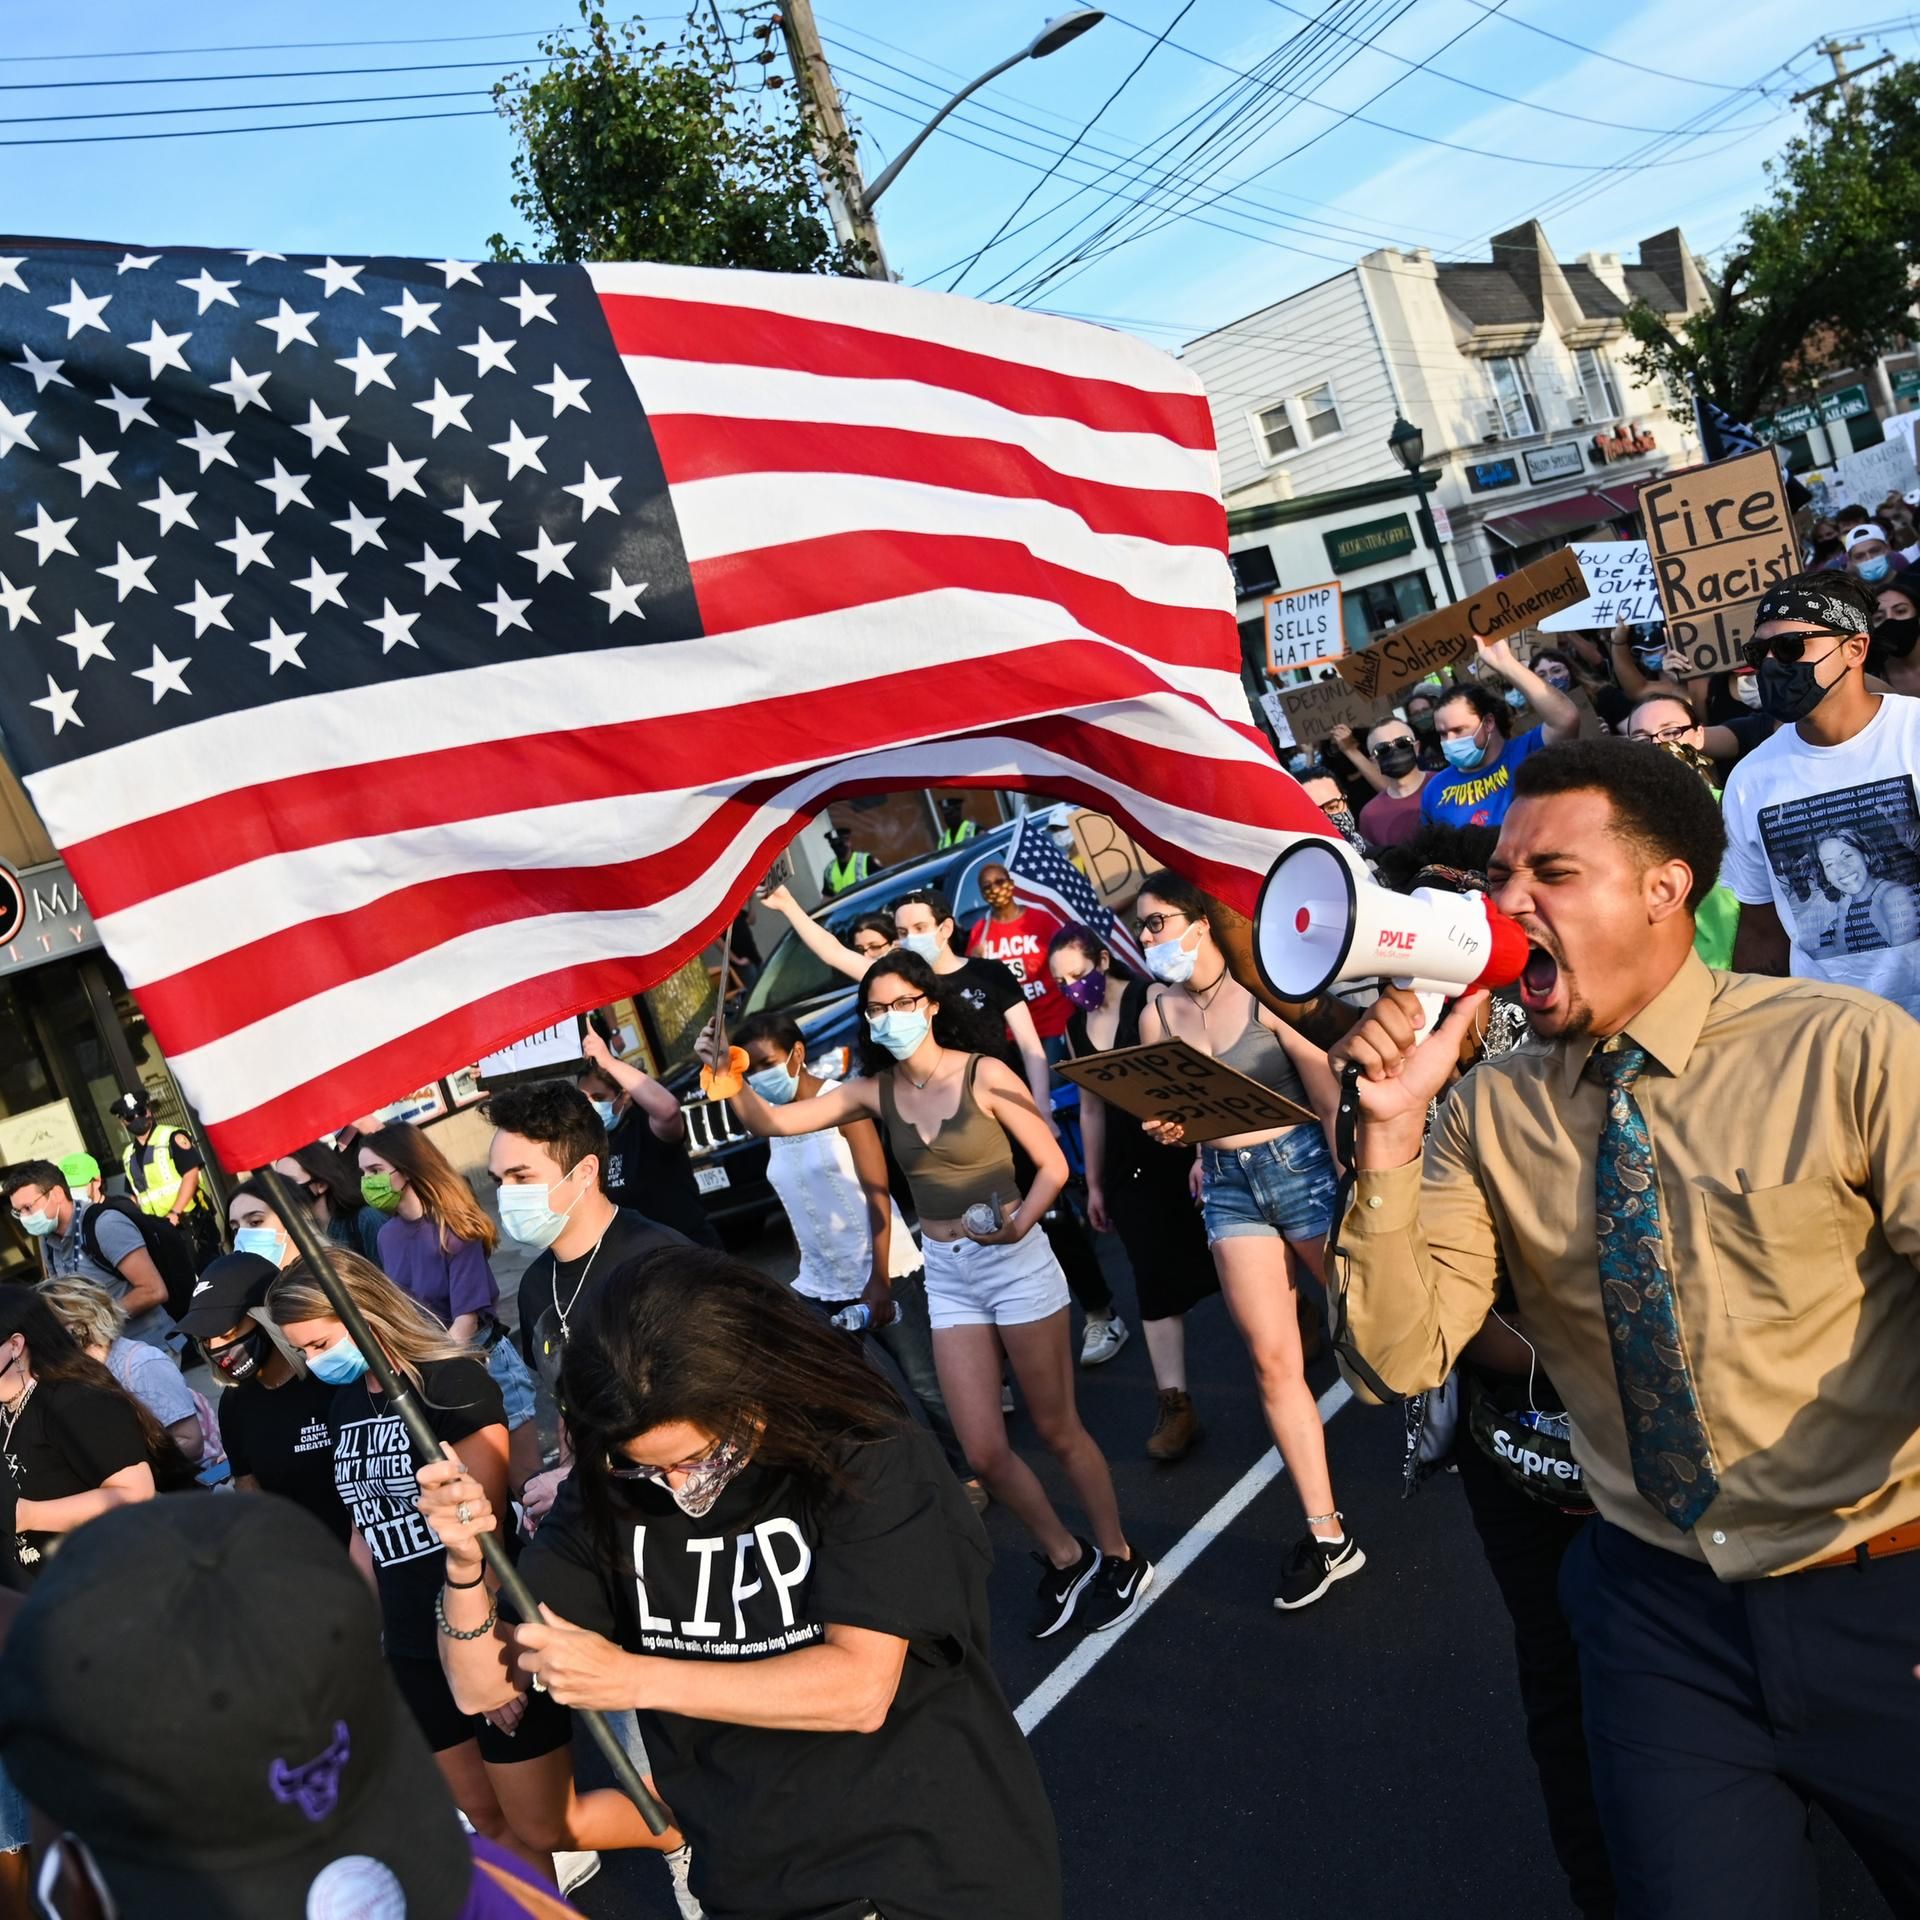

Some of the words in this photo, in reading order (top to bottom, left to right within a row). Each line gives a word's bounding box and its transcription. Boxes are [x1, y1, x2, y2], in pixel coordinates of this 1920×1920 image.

[1645, 483, 1779, 554] Fire
[1656, 543, 1792, 615] Racist
[1274, 589, 1331, 617] TRUMP
[1274, 615, 1327, 642] SELLS
[1383, 632, 1468, 678] Solitary
[1468, 566, 1579, 637] Confinement
[1274, 639, 1327, 667] HATE
[1672, 613, 1745, 670] Poli
[1353, 649, 1381, 699] Abolish
[1436, 764, 1509, 808] SPIDER-MAN
[1779, 803, 1808, 815] UARDIOLA.
[1378, 930, 1418, 950] PYLE
[1447, 924, 1479, 956] LIPP
[1085, 1049, 1216, 1082] Police
[1145, 1081, 1209, 1101] the
[1154, 1092, 1292, 1126] Police
[300, 1423, 328, 1435] STILL
[311, 1417, 315, 1425] I
[294, 1438, 332, 1453] BREATH
[300, 1431, 328, 1443] CAN'T
[334, 1427, 360, 1460] ALL
[366, 1422, 411, 1456] LIVES
[366, 1453, 414, 1479] MATTER
[354, 1479, 391, 1501] UNTIL
[352, 1499, 386, 1528] ACK
[363, 1512, 440, 1562] ATTE
[633, 1517, 812, 1640] LIPP
[655, 1634, 674, 1649] down
[674, 1636, 685, 1650] the
[703, 1640, 711, 1653] of
[711, 1640, 739, 1655] racism
[740, 1640, 768, 1655] across
[768, 1636, 786, 1651] long
[785, 1624, 813, 1645] Island
